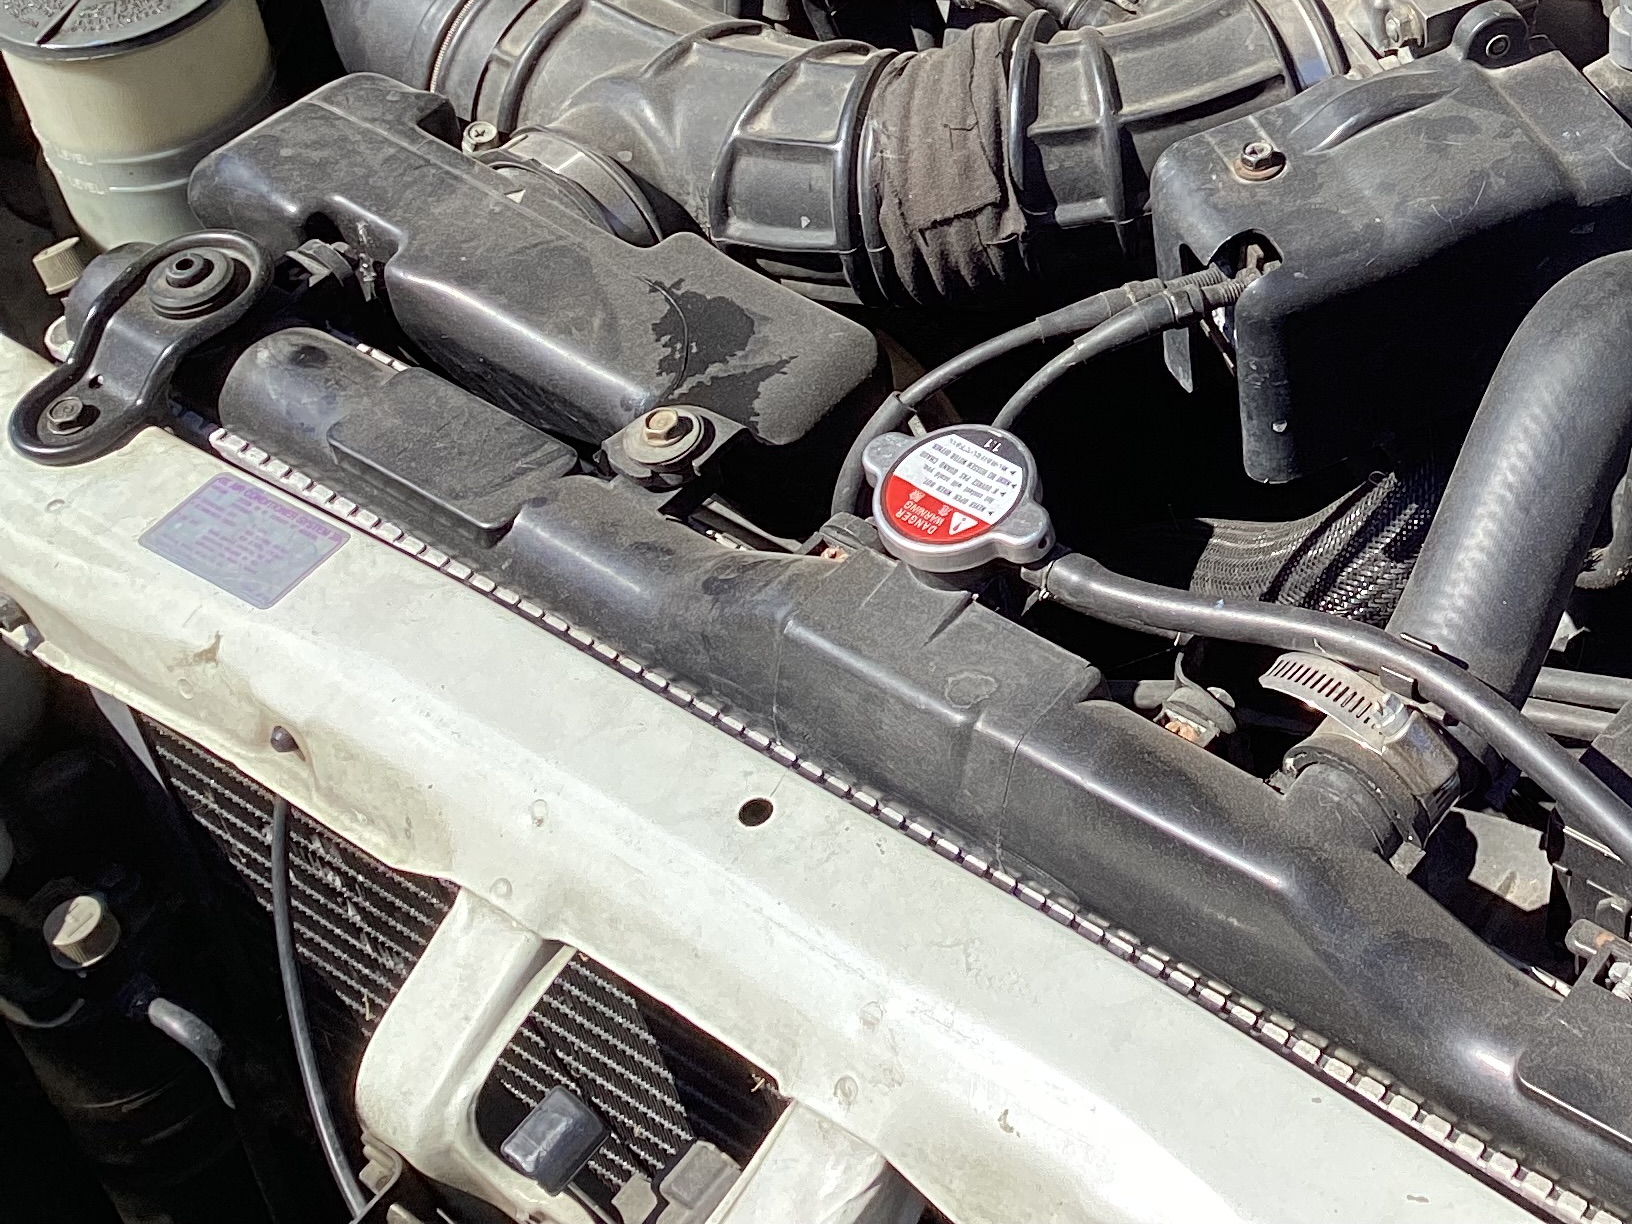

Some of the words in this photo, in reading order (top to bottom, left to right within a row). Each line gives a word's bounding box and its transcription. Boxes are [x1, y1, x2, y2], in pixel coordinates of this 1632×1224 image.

[953, 493, 968, 504] OPEN
[897, 508, 935, 534] DANGER
[905, 500, 942, 525] WARNING
